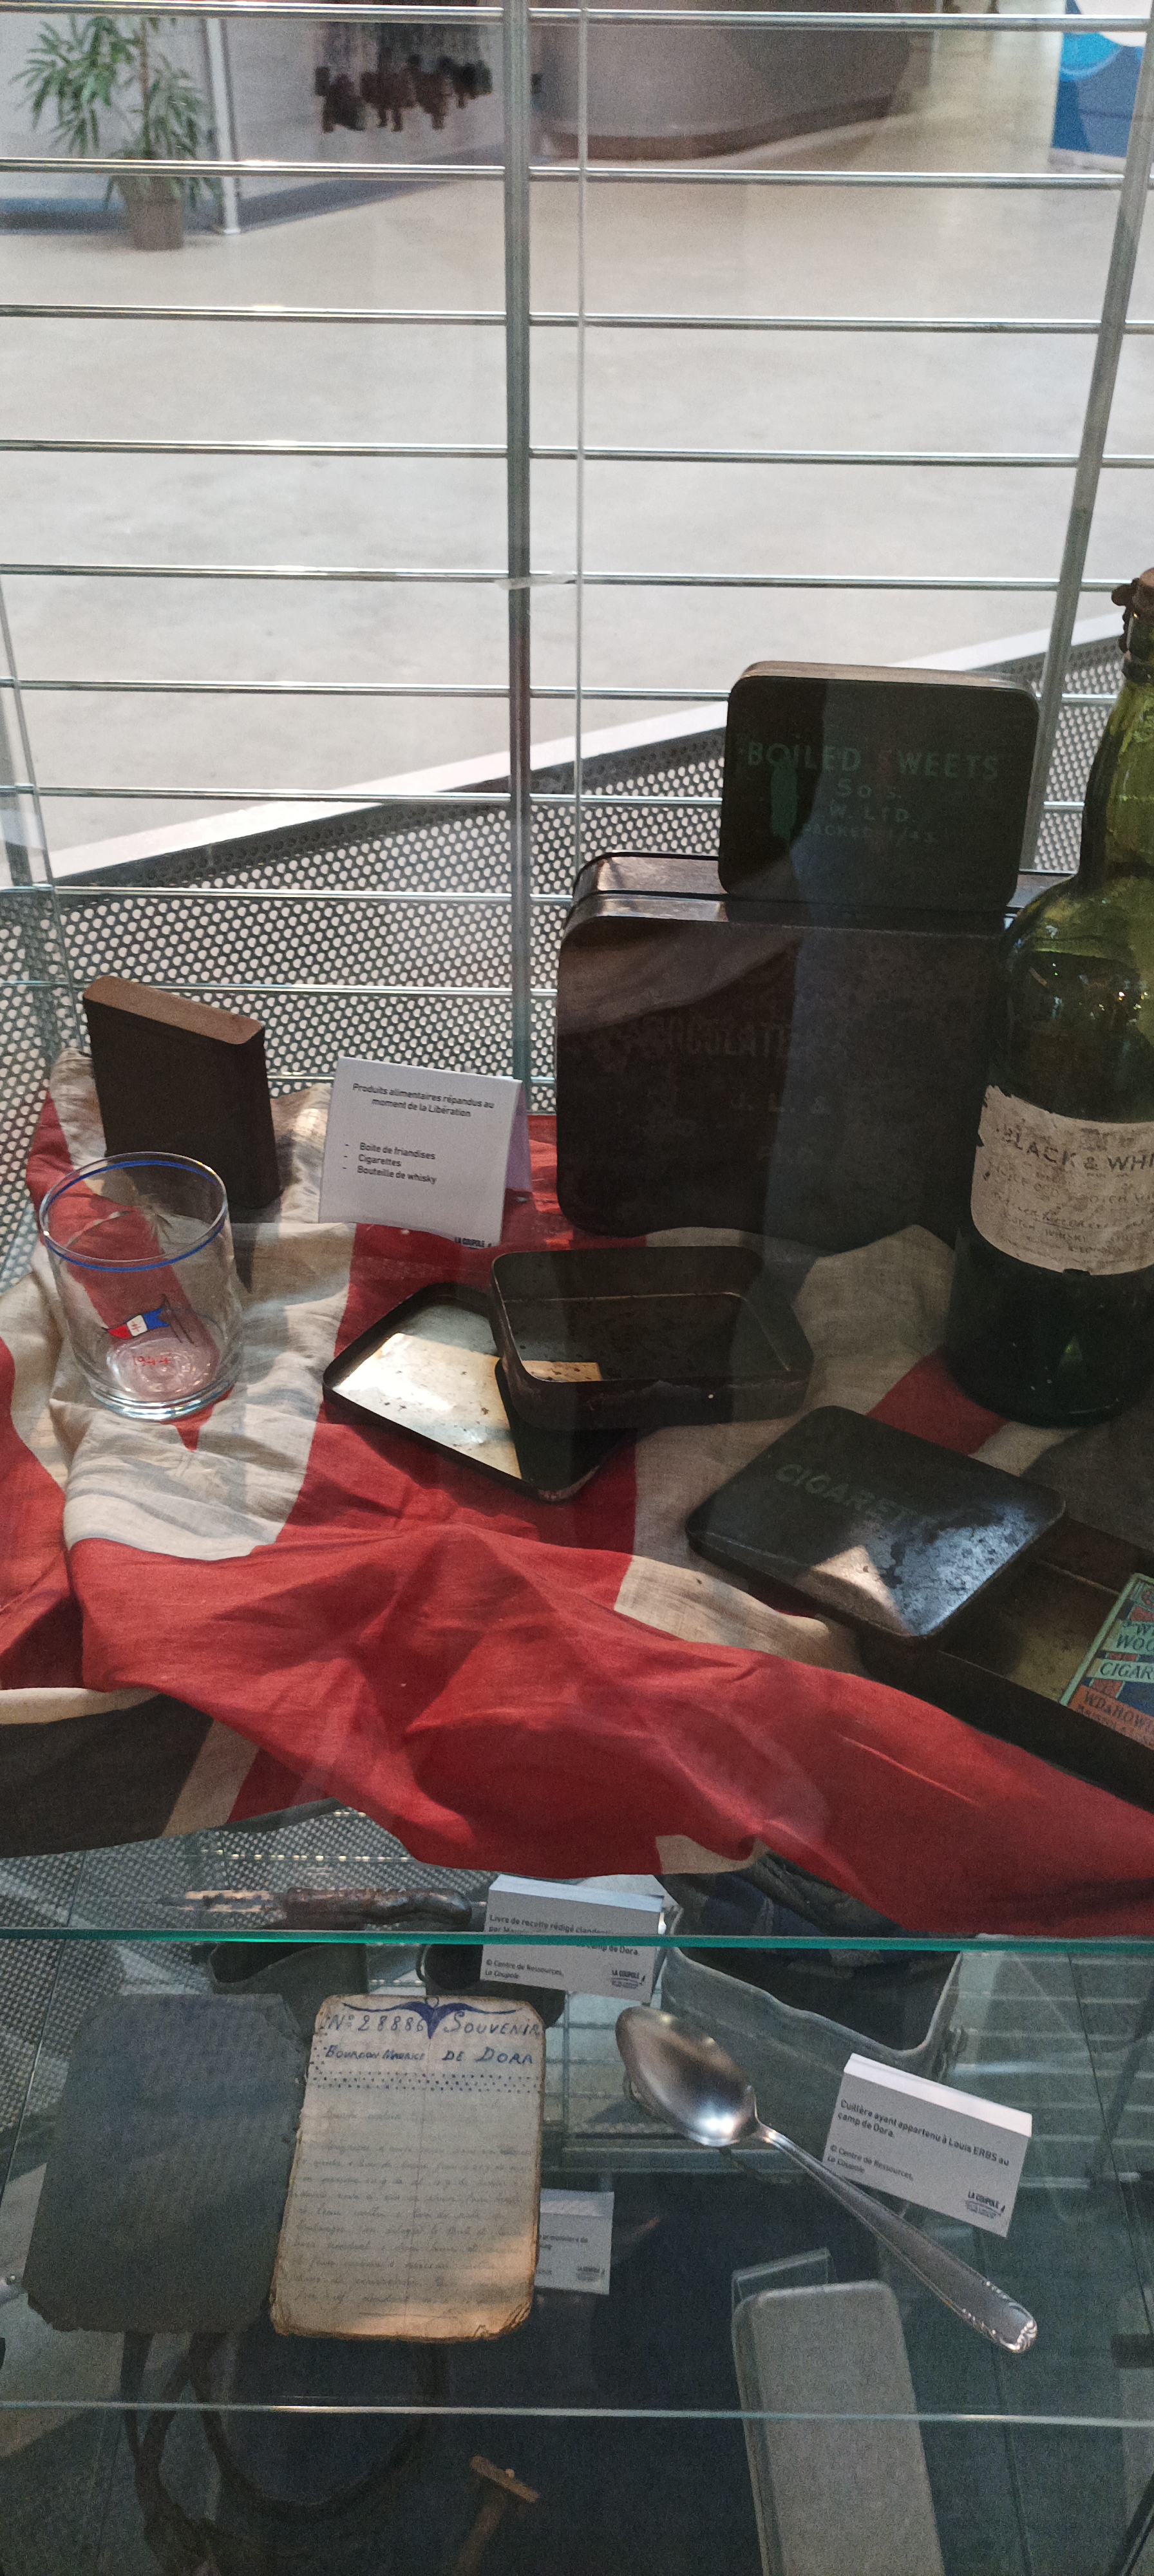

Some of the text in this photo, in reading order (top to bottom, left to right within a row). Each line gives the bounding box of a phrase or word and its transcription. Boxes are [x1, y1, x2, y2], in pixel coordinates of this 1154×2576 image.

[746, 741, 999, 782] BOILED SWEETS
[352, 1083, 388, 1095] Produits
[389, 1088, 442, 1102] alimentaires
[443, 1095, 482, 1107] répandus
[372, 1099, 471, 1117] moment de la Libération
[358, 1154, 402, 1166] Cigarettes
[383, 1146, 393, 1154] de
[393, 1146, 435, 1159] friandises
[357, 1165, 437, 1185] Bouteille de whisky
[489, 1915, 509, 1924] Livre
[494, 1960, 516, 1969] Centre
[443, 2011, 543, 2036] SOUVENIR
[441, 2047, 533, 2065] DE DORA
[837, 2112, 860, 2126] camp
[861, 2120, 872, 2130] de
[840, 2098, 1010, 2166] Cuillère ayant appartenu à Louis ERBS au
[838, 2146, 862, 2162] Centre
[863, 2156, 873, 2165] de
